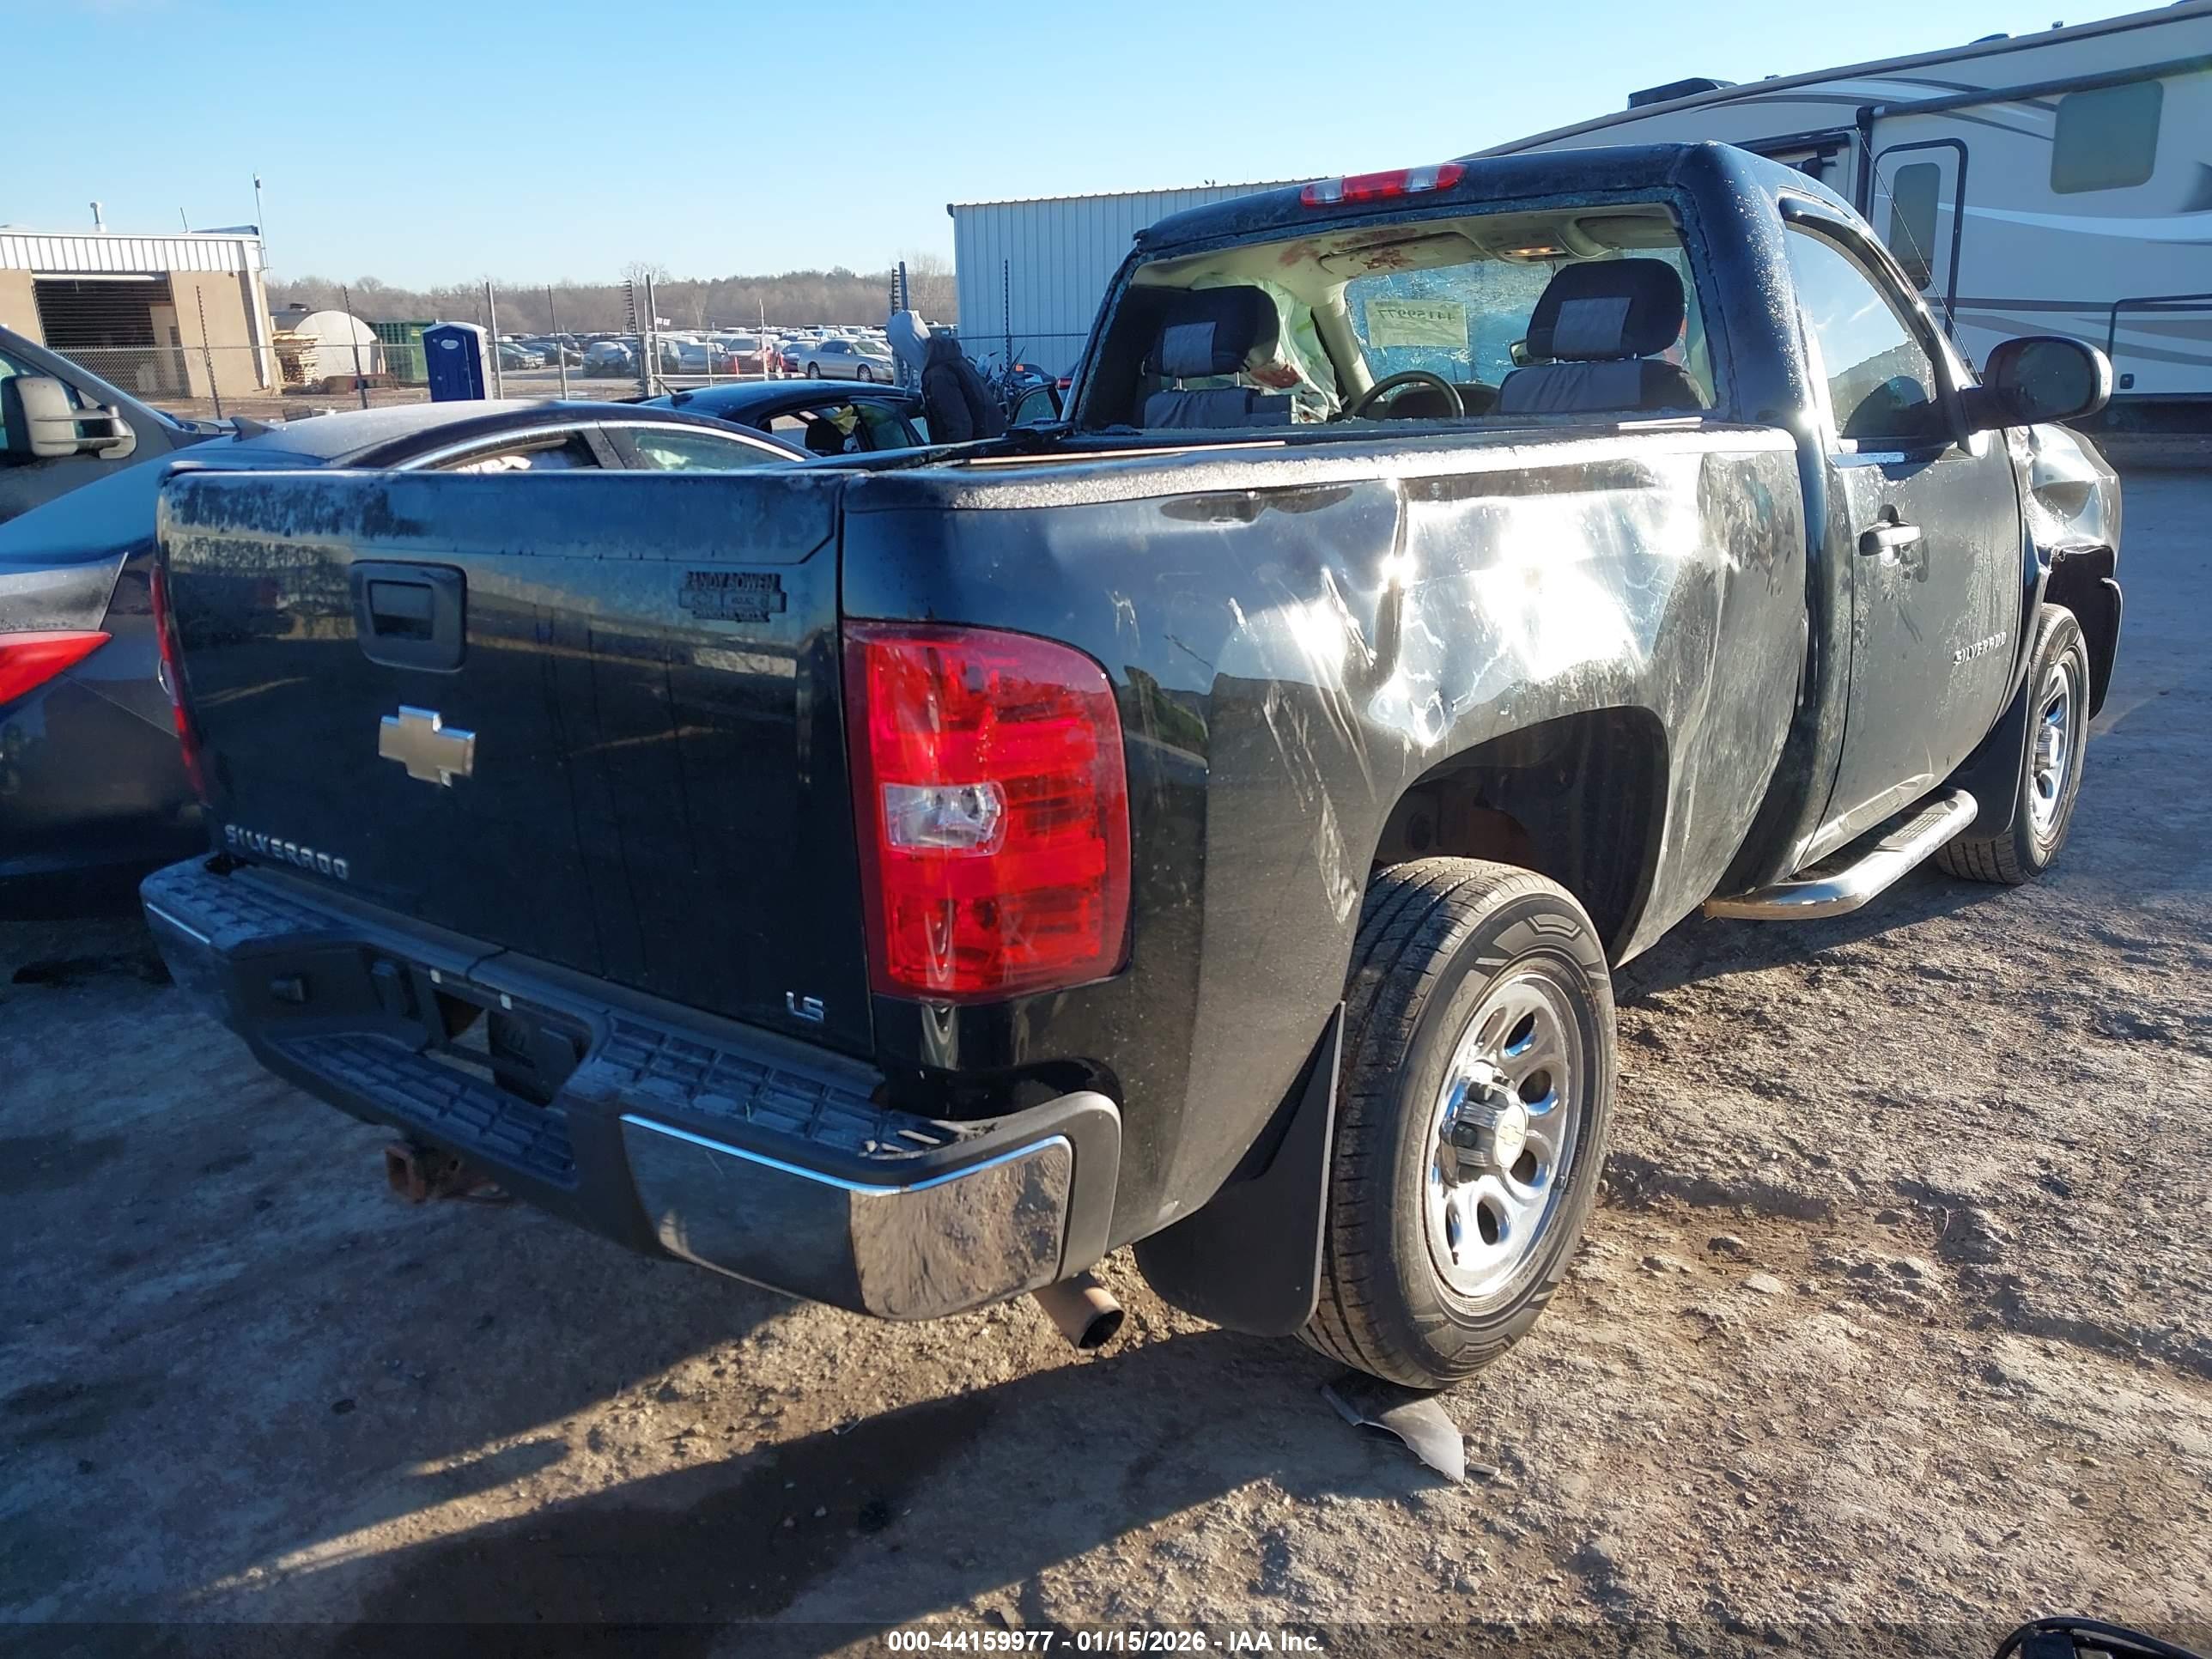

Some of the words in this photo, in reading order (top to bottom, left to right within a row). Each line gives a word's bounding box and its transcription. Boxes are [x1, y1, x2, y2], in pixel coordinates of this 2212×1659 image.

[1953, 631, 2007, 667] SILVERADO
[224, 823, 349, 881] SILVERADO
[786, 991, 824, 1024] LS
